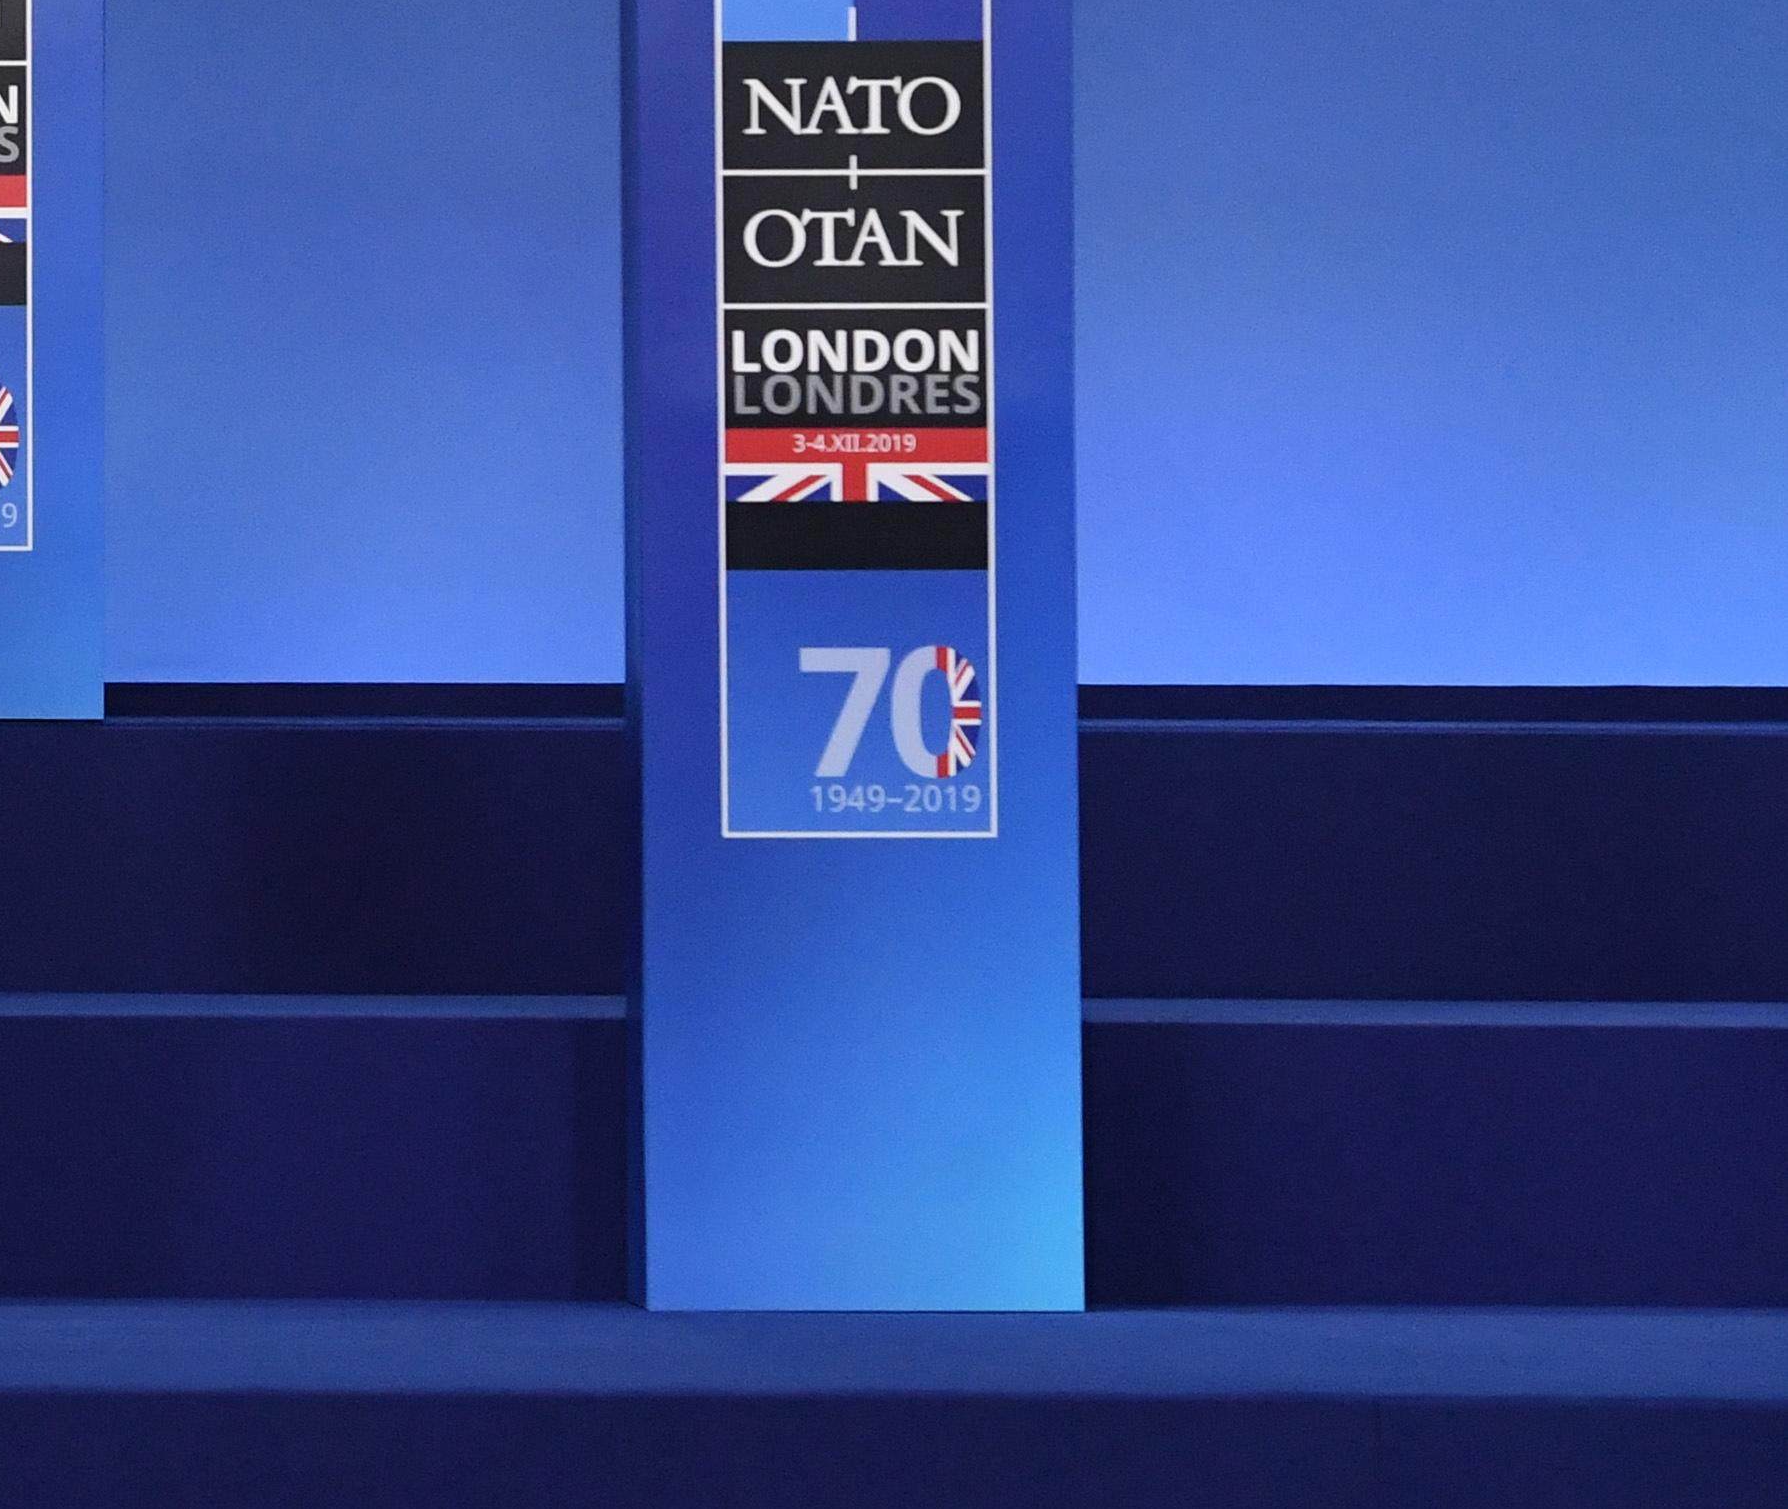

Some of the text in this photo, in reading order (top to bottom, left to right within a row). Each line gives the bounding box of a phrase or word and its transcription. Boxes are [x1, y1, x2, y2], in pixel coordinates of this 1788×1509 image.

[743, 77, 960, 135] NATO
[744, 209, 964, 267] OTAN
[733, 329, 978, 372] LONDON
[734, 374, 981, 415] LONDRES
[793, 433, 916, 452] 3-4.XII.2019
[801, 646, 982, 778] 70
